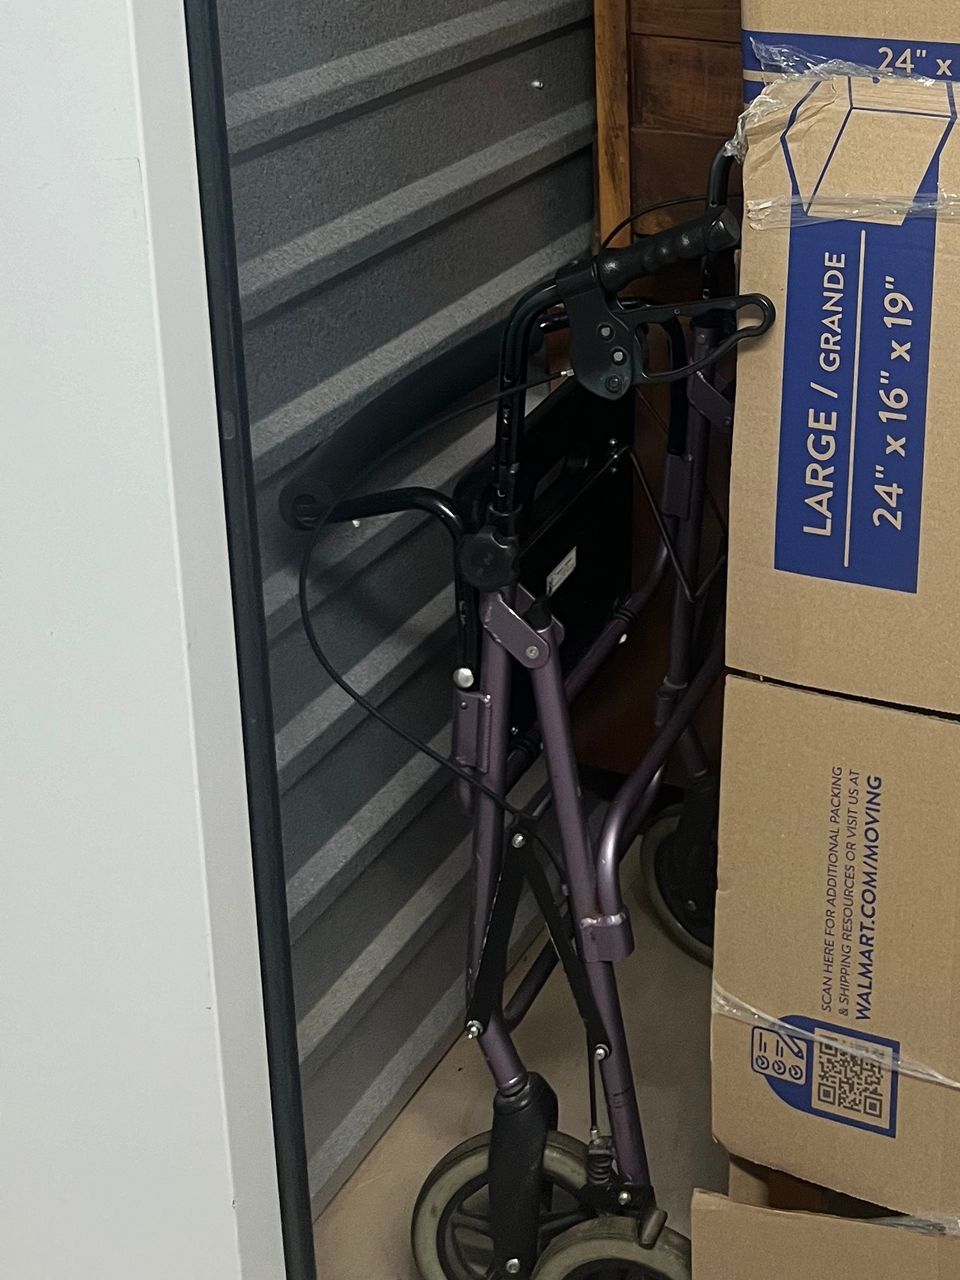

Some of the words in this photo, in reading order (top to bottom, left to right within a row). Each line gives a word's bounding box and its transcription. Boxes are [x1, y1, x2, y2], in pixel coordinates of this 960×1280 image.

[878, 46, 927, 75] 24"
[936, 58, 952, 76] x
[818, 251, 846, 372] GRANDE
[883, 275, 914, 328] 19"
[890, 339, 911, 362] x
[810, 382, 838, 398] /
[878, 370, 909, 423] 16"
[885, 434, 907, 457] x
[802, 408, 838, 536] LARGE
[872, 464, 904, 530] 24"
[849, 768, 860, 786] AT
[829, 766, 842, 824] PACKING
[848, 788, 859, 805] US
[846, 807, 859, 839] VISIT
[826, 826, 840, 907] ADDITIONAL
[845, 841, 857, 861] OR
[841, 864, 856, 942] RESOURCES
[855, 775, 882, 1020] WALMART.COM/MOVING
[825, 909, 836, 936] FOR
[823, 938, 834, 973] HERE
[839, 944, 852, 1005] SHIPPING
[821, 977, 832, 1012] SCAN
[838, 1008, 849, 1017] &
